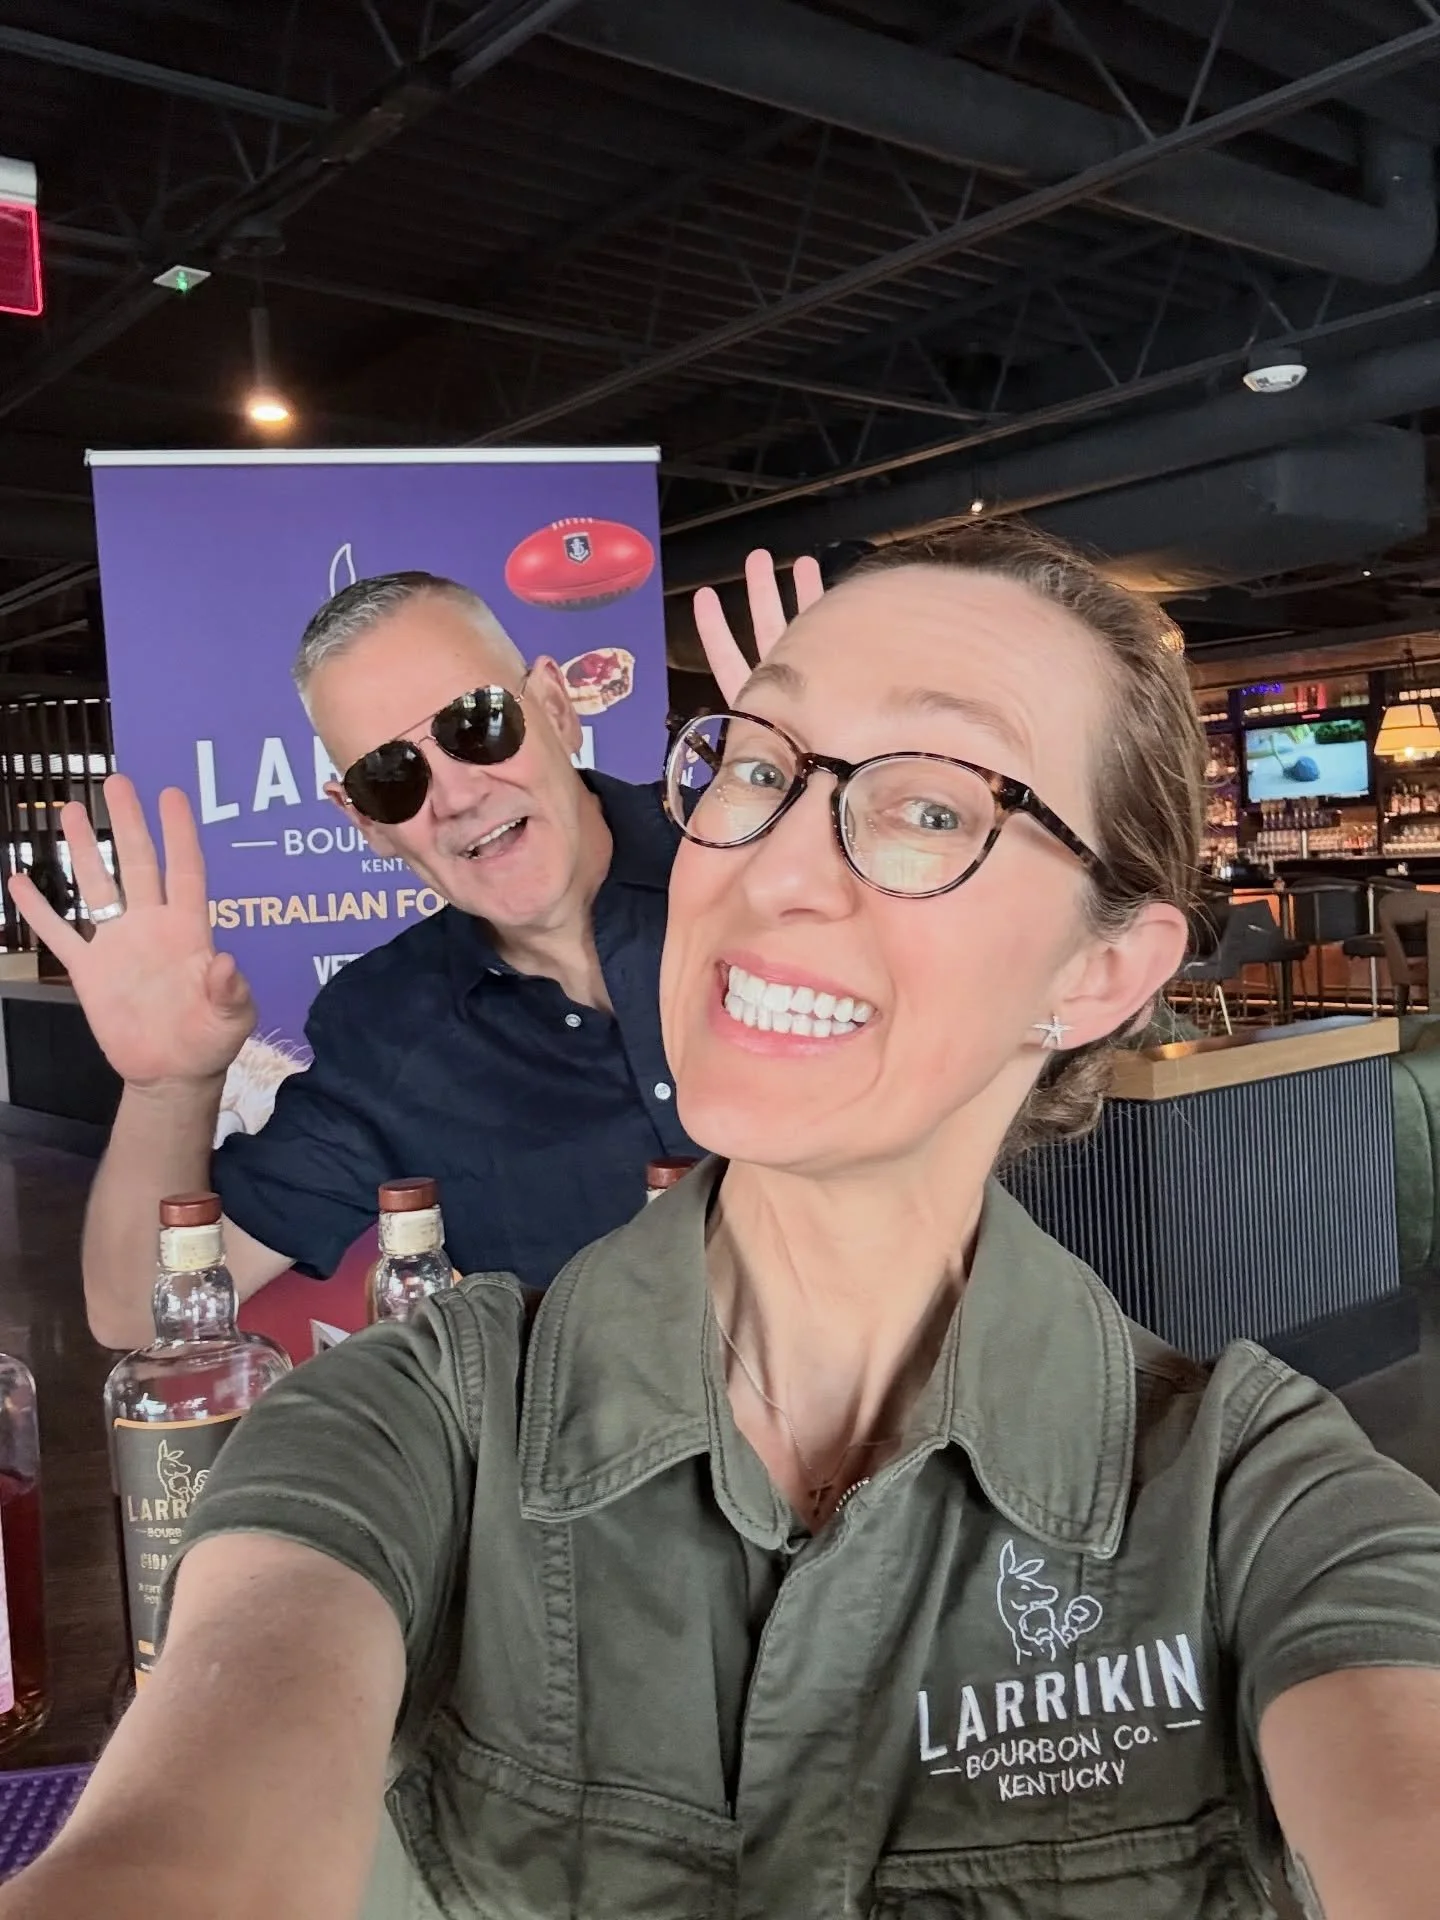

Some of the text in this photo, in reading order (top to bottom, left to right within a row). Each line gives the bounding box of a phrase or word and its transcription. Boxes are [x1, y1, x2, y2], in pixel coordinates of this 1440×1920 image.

[917, 1633, 1205, 1762] LARRIKIN
[966, 1724, 1158, 1780] BOURBON Co.
[998, 1758, 1126, 1801] KENTUCKY
